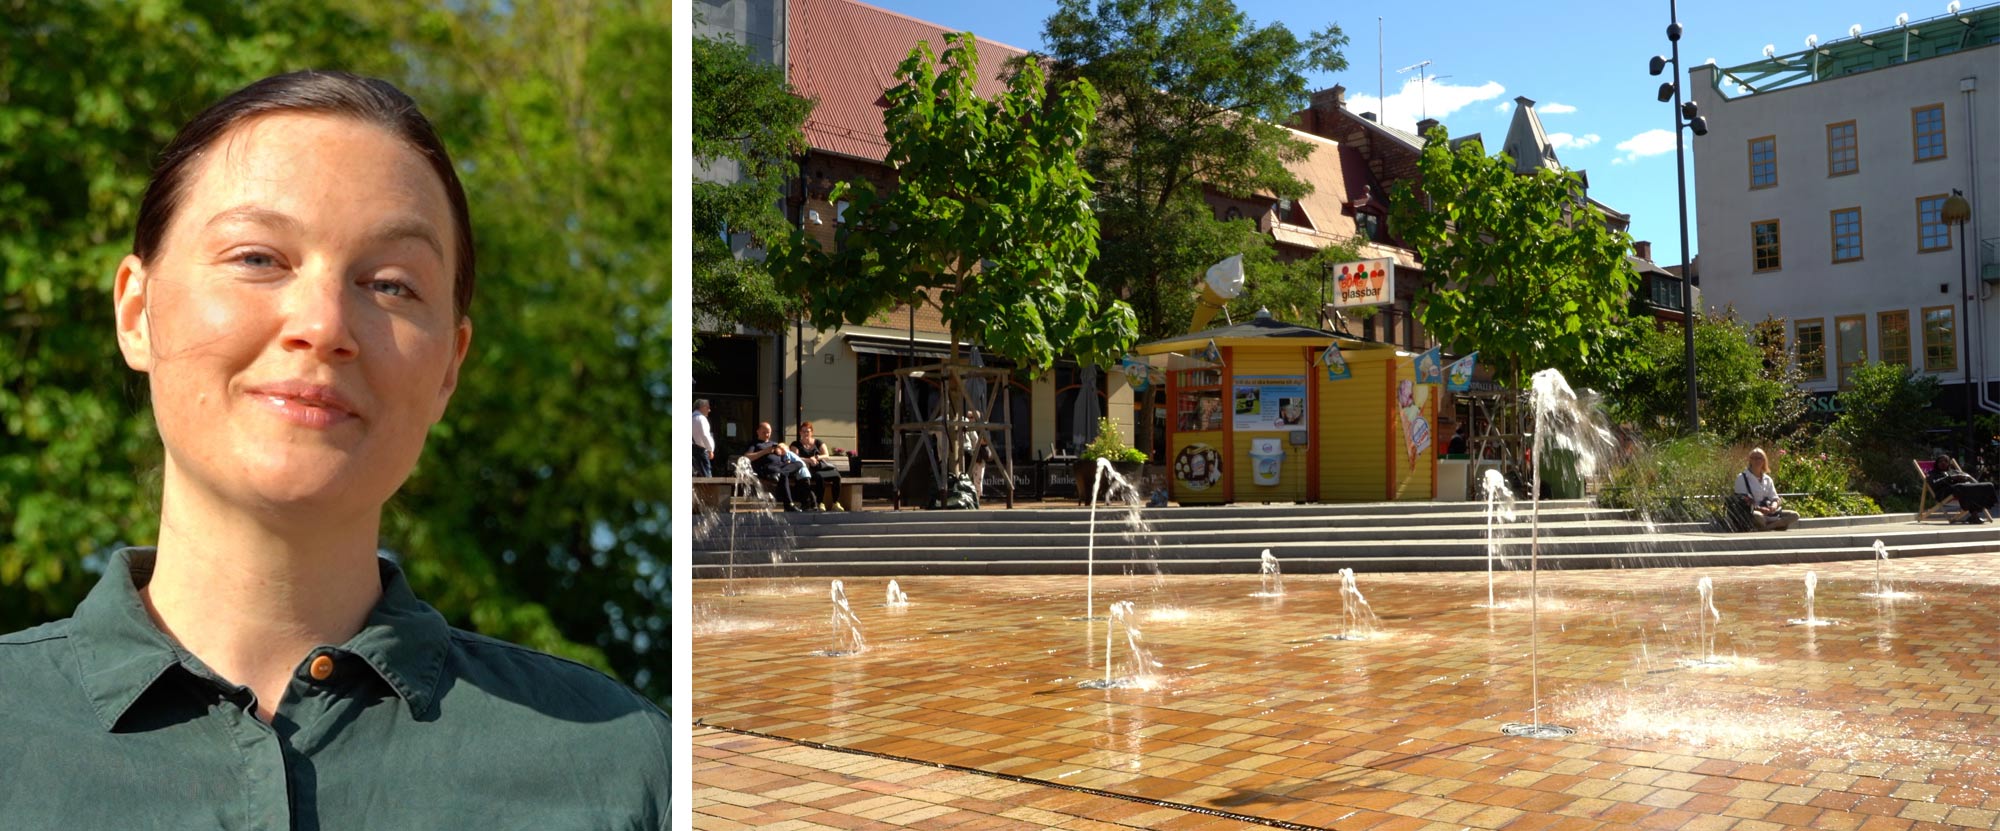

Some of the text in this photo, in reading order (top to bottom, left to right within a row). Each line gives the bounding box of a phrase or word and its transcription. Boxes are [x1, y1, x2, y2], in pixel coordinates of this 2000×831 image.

[1341, 287, 1381, 302] glassbar
[1013, 474, 1031, 486] Pub
[1050, 474, 1077, 486] Banke
